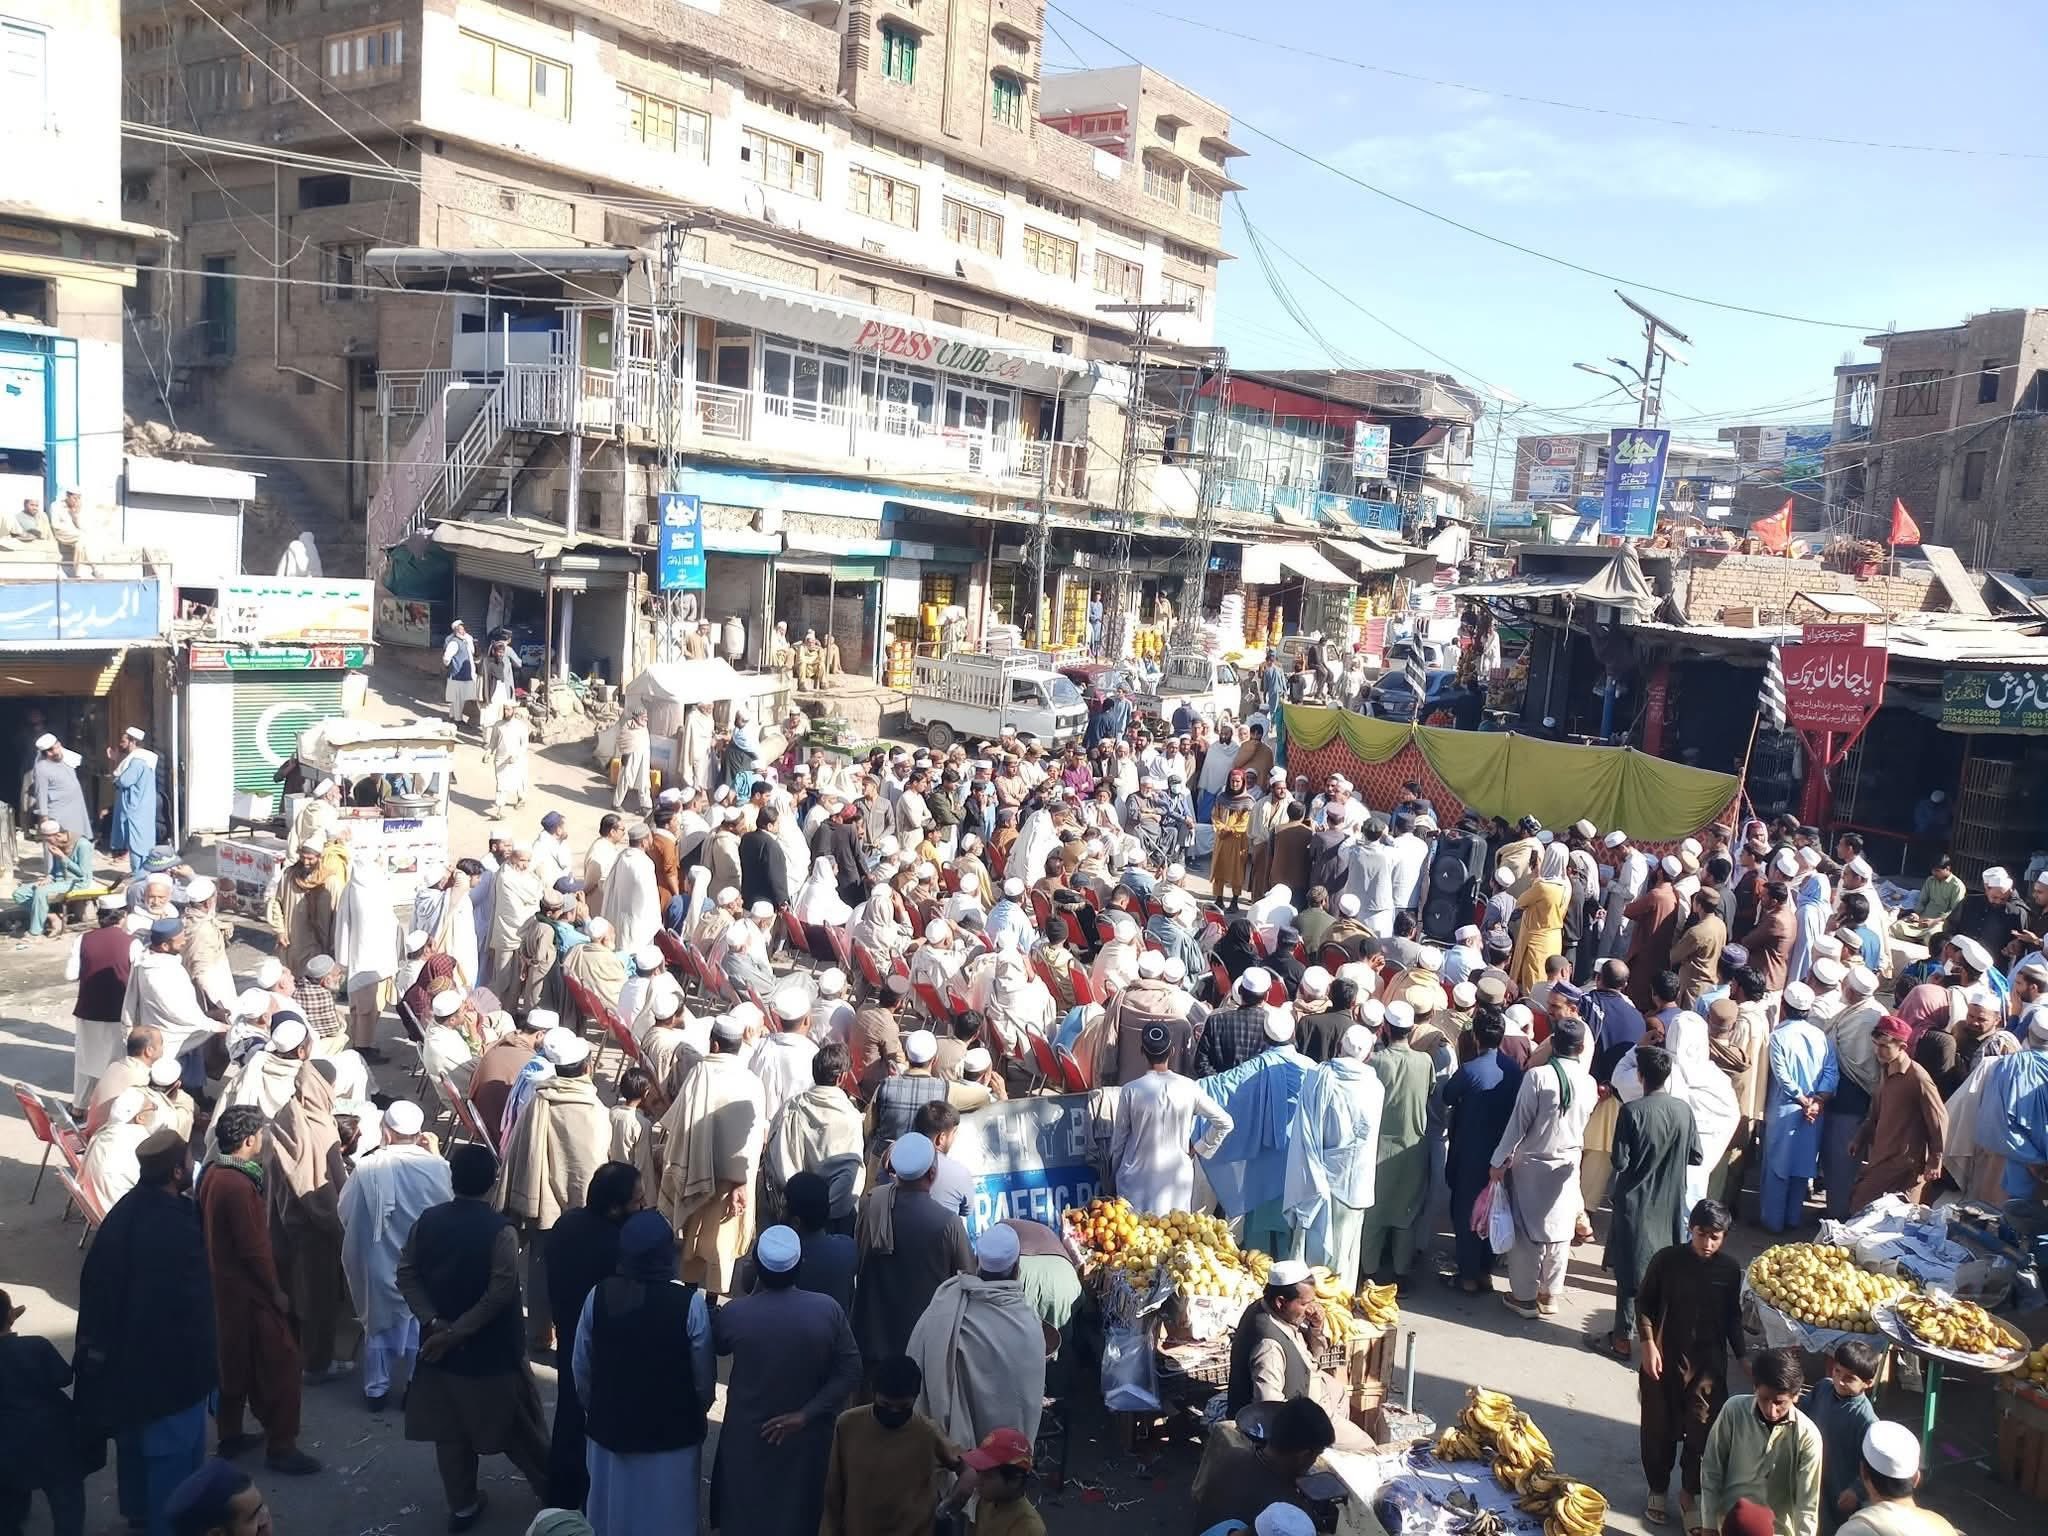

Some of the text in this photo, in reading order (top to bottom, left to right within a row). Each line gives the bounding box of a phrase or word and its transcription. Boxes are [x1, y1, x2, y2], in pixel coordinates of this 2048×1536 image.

[854, 319, 937, 361] PRESS
[935, 341, 990, 373] CLUB
[520, 644, 546, 657] PEPS
[1786, 651, 1873, 697] باچا خان چوک
[1985, 671, 2035, 711] فروش
[962, 1184, 1069, 1236] RAFFIC
